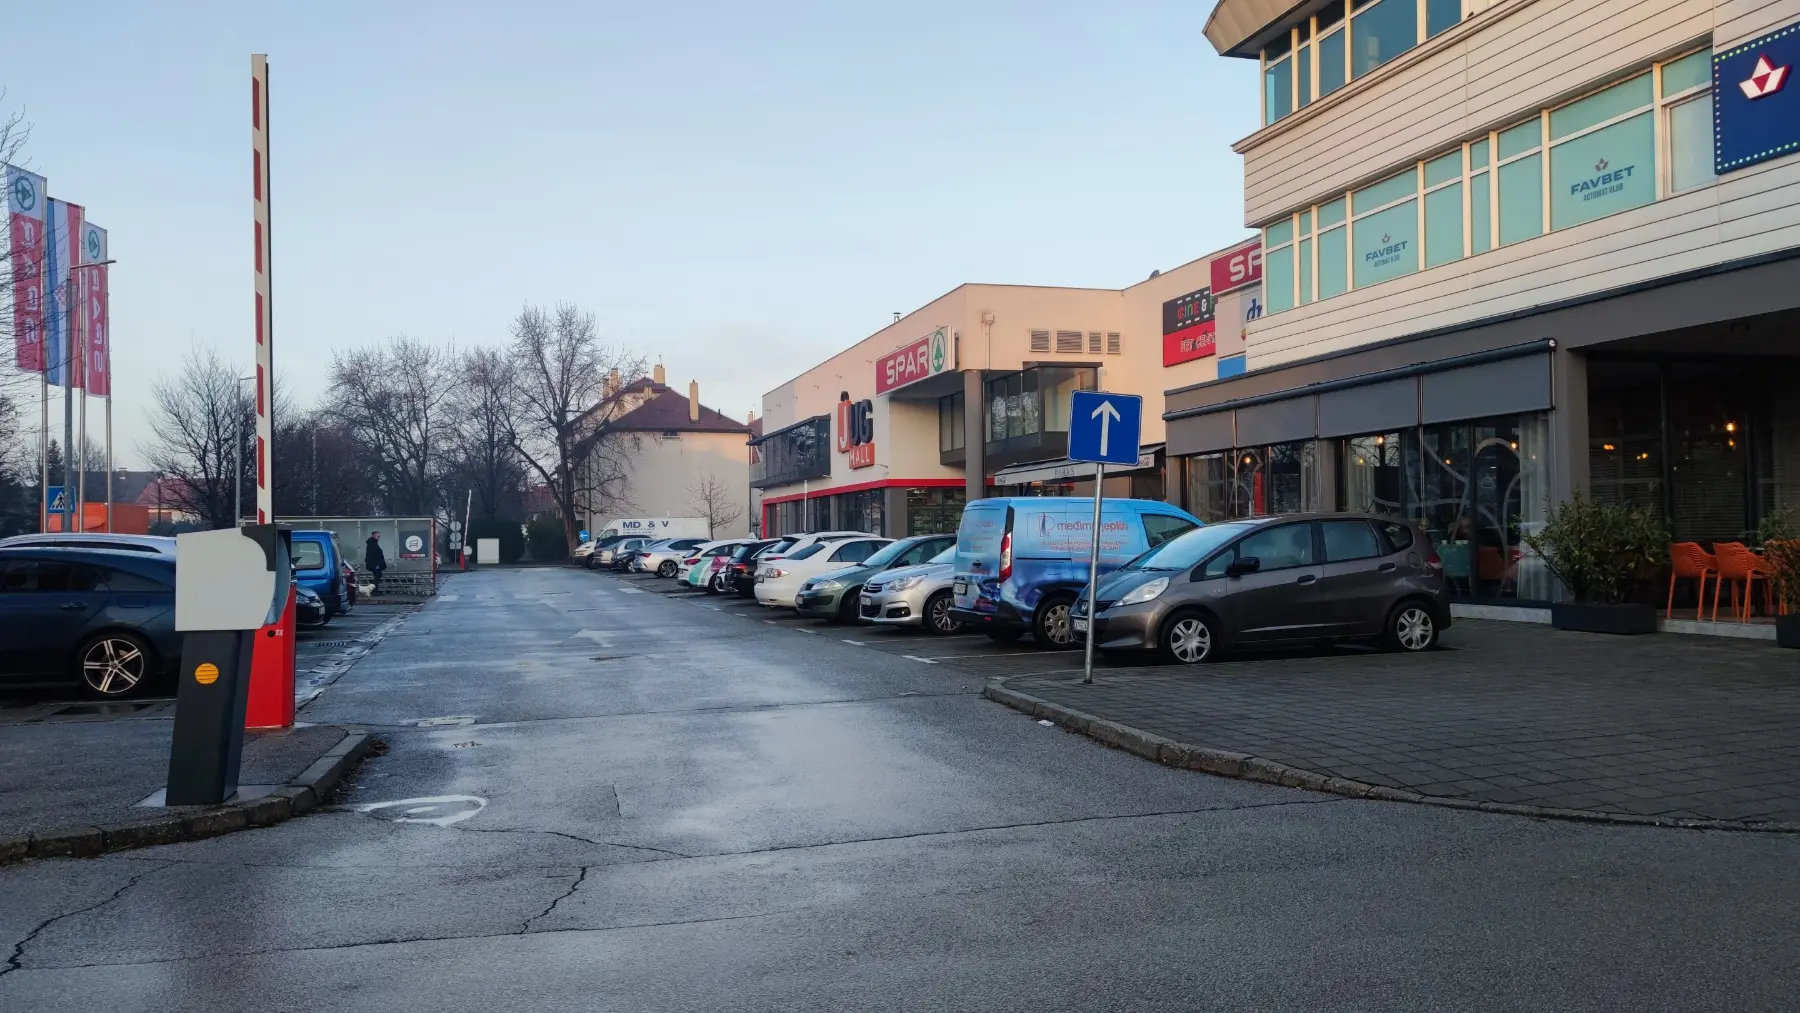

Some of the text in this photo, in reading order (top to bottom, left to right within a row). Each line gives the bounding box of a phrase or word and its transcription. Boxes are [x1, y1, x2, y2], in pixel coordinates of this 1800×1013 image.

[1571, 165, 1635, 195] FAVBET
[1365, 240, 1408, 261] FAVBET
[886, 344, 928, 385] SPAR
[838, 397, 874, 449] JUG
[849, 446, 871, 466] MALL
[622, 520, 669, 529] MD & V
